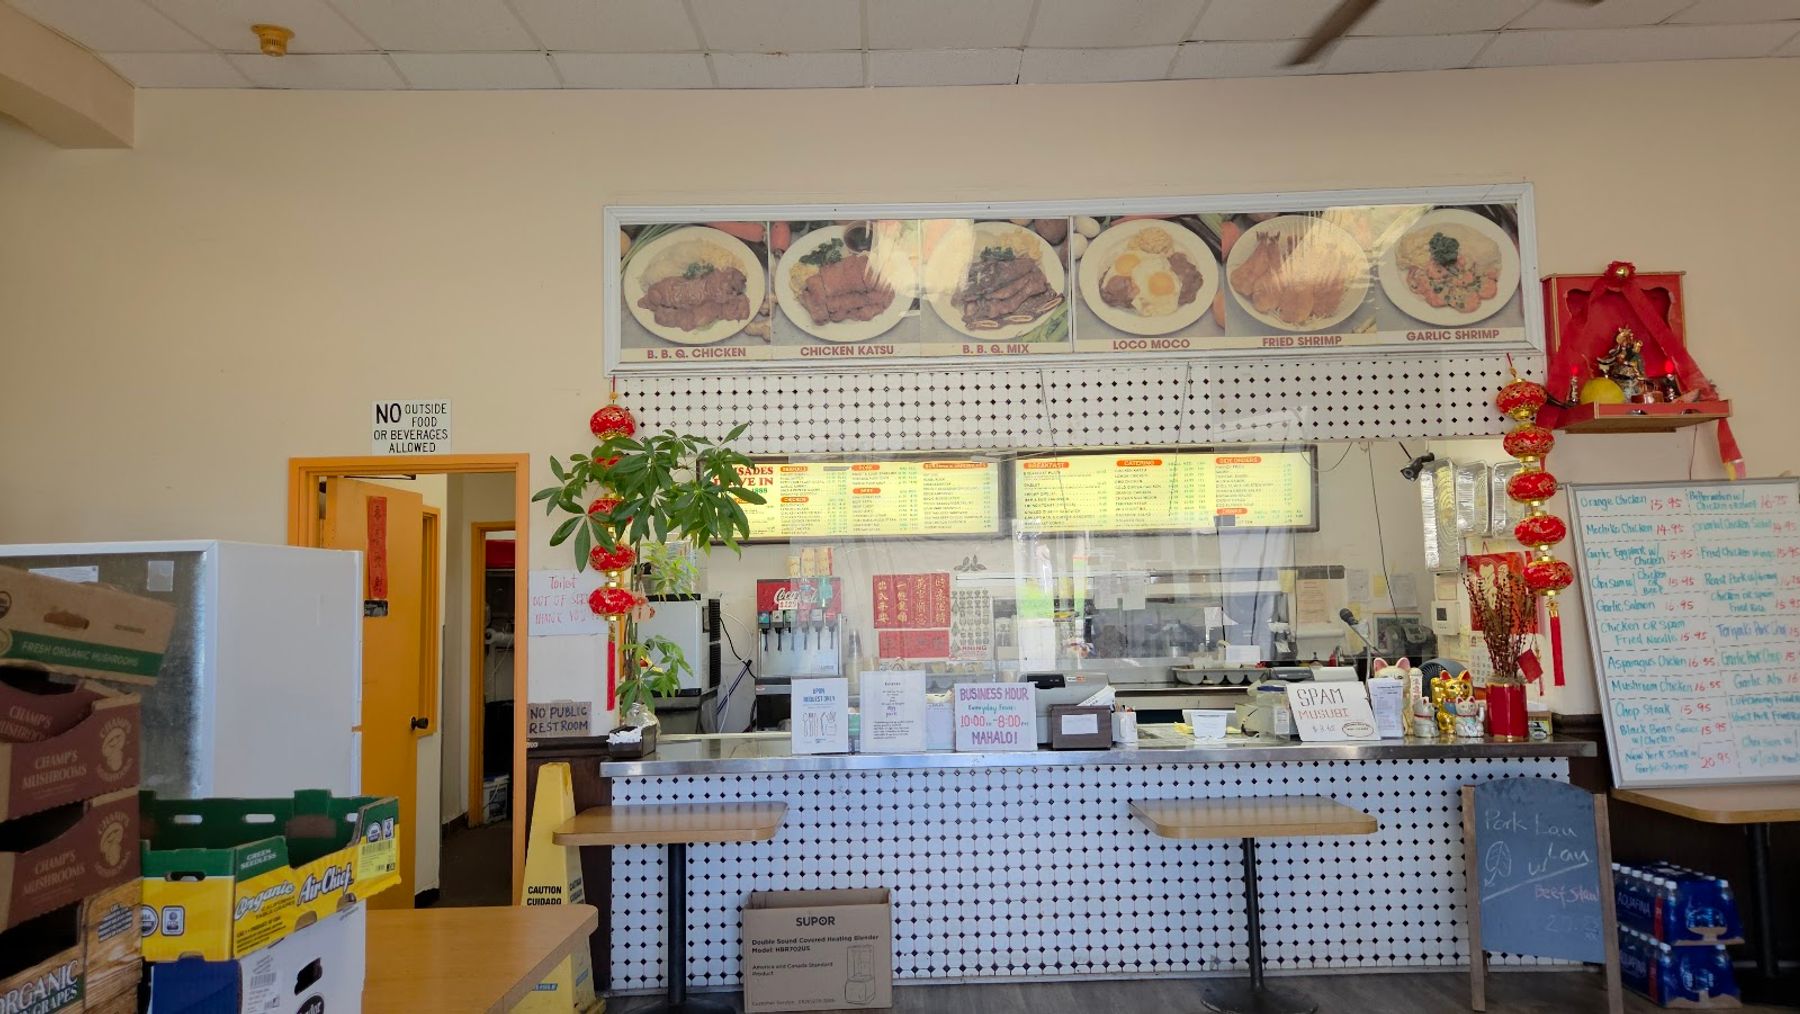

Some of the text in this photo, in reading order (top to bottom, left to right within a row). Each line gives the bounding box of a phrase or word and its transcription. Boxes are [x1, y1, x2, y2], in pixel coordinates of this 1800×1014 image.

[1262, 335, 1342, 347] FRIED SHRIMP
[1406, 329, 1500, 341] GARLIC SHRIMP
[1007, 344, 1029, 354] MIX
[1112, 338, 1190, 350] LOCO MOCO
[692, 347, 746, 358] CHICKEN
[800, 345, 894, 357] CHICKEN KATSU
[376, 403, 447, 424] NO OUTSIDE
[412, 416, 437, 427] FOOD
[374, 429, 448, 440] OR BEVERAGES
[389, 443, 436, 453] ALLOWED
[1581, 497, 1613, 511] Orange
[1615, 494, 1647, 506] Chicken
[1621, 522, 1653, 534] Chicken
[1700, 546, 1721, 559] Fried
[1634, 555, 1665, 566] Chicken
[1638, 568, 1666, 580] Chicken
[548, 574, 577, 590] Toilet
[533, 594, 552, 606] OUT
[1596, 599, 1656, 612] Garlic Salmon
[1601, 621, 1639, 633] Chicken
[1615, 634, 1642, 646] Fried
[22, 641, 50, 655] FRESH
[52, 645, 90, 660] ORGANIC
[1608, 655, 1655, 673] Asparagus
[1658, 654, 1687, 667] Chicken
[1611, 680, 1658, 692] Mushroom
[1660, 676, 1693, 692] Chicken
[960, 687, 1029, 701] BUSINESS HOUR
[1297, 688, 1344, 707] SPAM
[530, 705, 588, 719] NO PUBLIC
[1298, 707, 1350, 720] MUSUBI
[1615, 701, 1640, 720] Chop
[529, 720, 589, 734] RESTROOM
[1619, 723, 1648, 735] Black
[1649, 723, 1673, 734] Bean
[35, 750, 78, 770] CHAMP'S
[22, 763, 88, 789] MUSHROOMS
[240, 852, 277, 869] SEEDLESS
[246, 848, 272, 860] GREEN
[34, 849, 77, 875] CHAMP'S
[23, 863, 86, 895] MUSHROOMS
[528, 886, 562, 895] CAUTION
[234, 879, 295, 920] Organic
[527, 898, 562, 906] CUIDADO
[796, 916, 836, 927] SUPOR
[752, 934, 879, 947] Double Sound Covered Heating Blender
